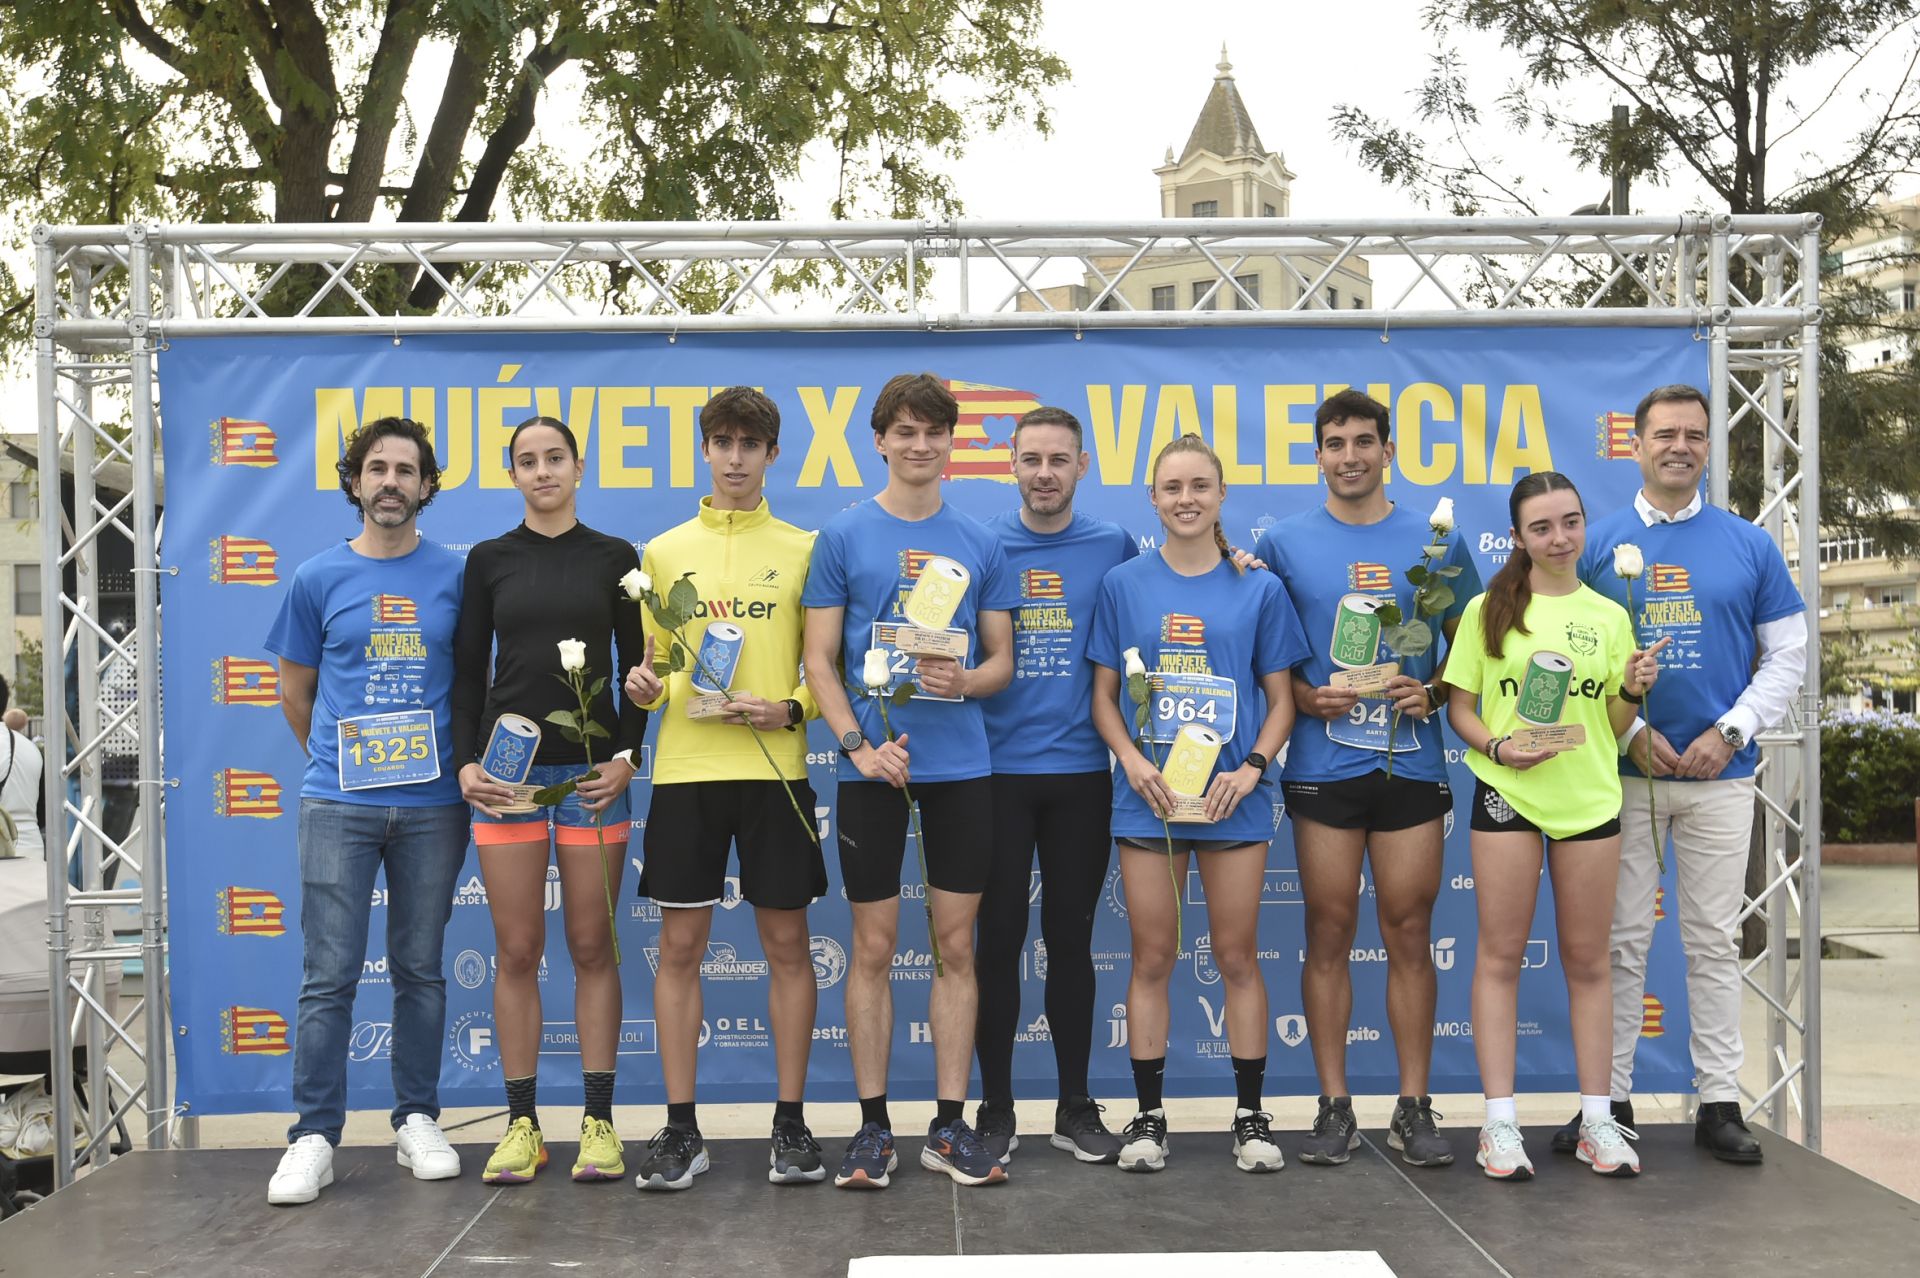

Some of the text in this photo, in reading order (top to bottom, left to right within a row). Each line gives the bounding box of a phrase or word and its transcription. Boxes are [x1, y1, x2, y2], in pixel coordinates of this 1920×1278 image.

[315, 365, 1556, 490] MUÉVET X VALECIA
[689, 597, 777, 620] awter
[1020, 606, 1067, 621] MUÉVETE
[1645, 599, 1694, 614] MUÉVETE
[1024, 618, 1073, 631] VALENCIA
[1640, 611, 1703, 625] X VALENCIA
[370, 631, 421, 646] MUÉVETE
[365, 645, 427, 658] X VALENCIA
[1159, 652, 1207, 667] MUÉVETE
[1158, 697, 1217, 723] 964
[349, 735, 430, 766] 1325
[1275, 882, 1299, 892] LOLI
[631, 905, 646, 917] LAS
[1349, 949, 1388, 962] RDAD
[889, 971, 931, 981] FITNESS
[470, 1028, 491, 1055] F
[1197, 1042, 1211, 1054] LAS
